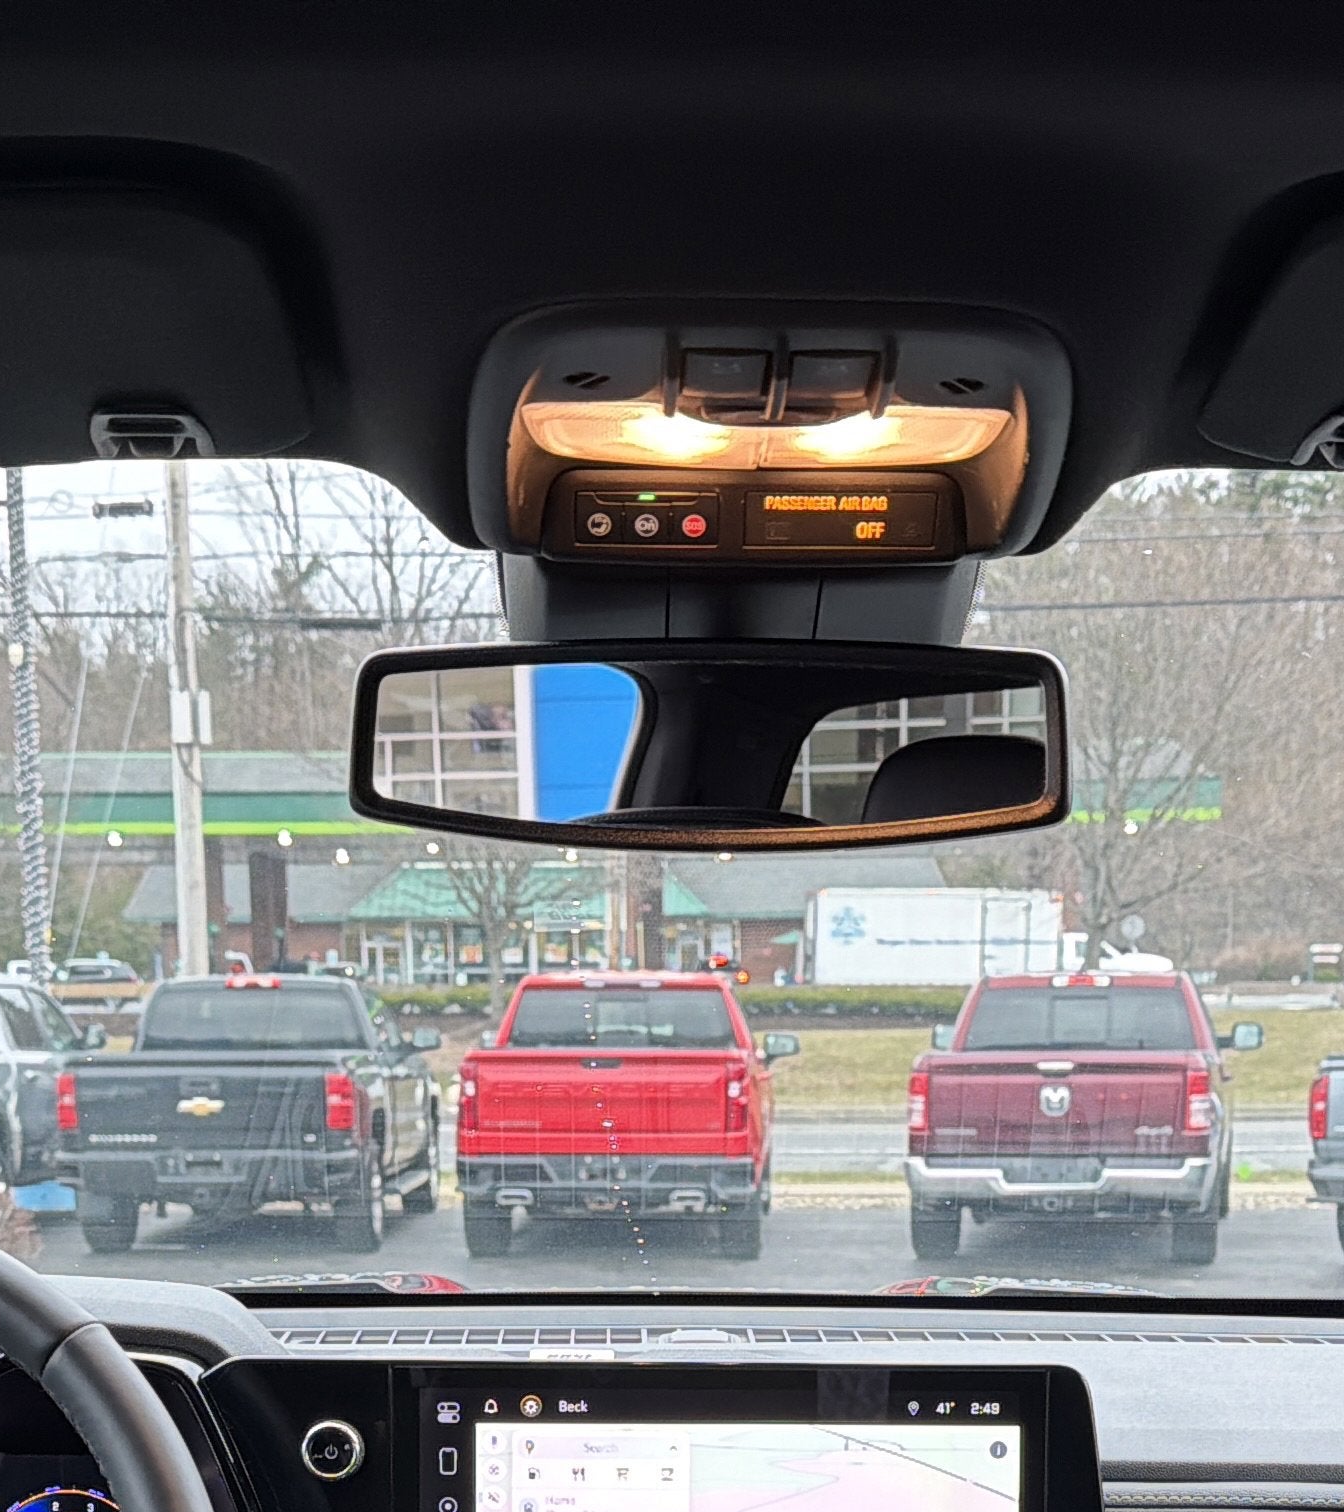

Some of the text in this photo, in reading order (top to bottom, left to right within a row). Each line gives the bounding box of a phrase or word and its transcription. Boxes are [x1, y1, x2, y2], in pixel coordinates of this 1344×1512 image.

[763, 494, 888, 512] PASSENGER AIR BAG
[855, 521, 886, 539] OFF
[558, 1400, 588, 1413] Beck
[969, 1402, 1001, 1415] 2:49
